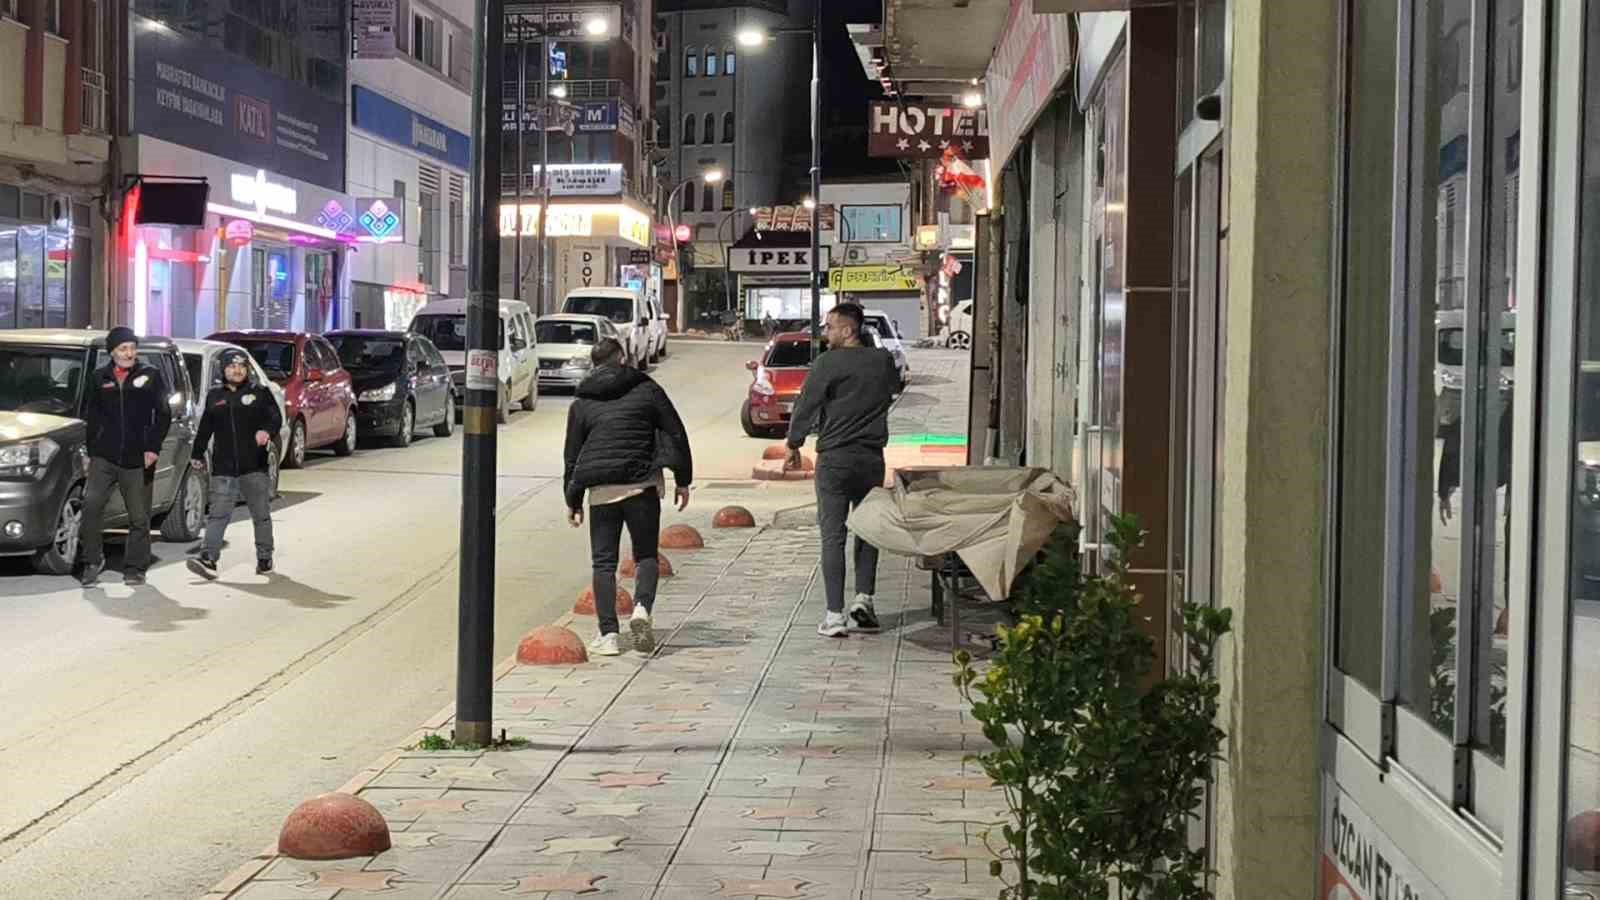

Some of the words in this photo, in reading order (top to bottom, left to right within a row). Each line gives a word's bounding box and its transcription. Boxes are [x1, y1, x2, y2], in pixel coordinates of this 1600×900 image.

[873, 105, 988, 137] HOTEL
[748, 249, 808, 266] İPEK
[1331, 796, 1373, 897] ÖZCAN
